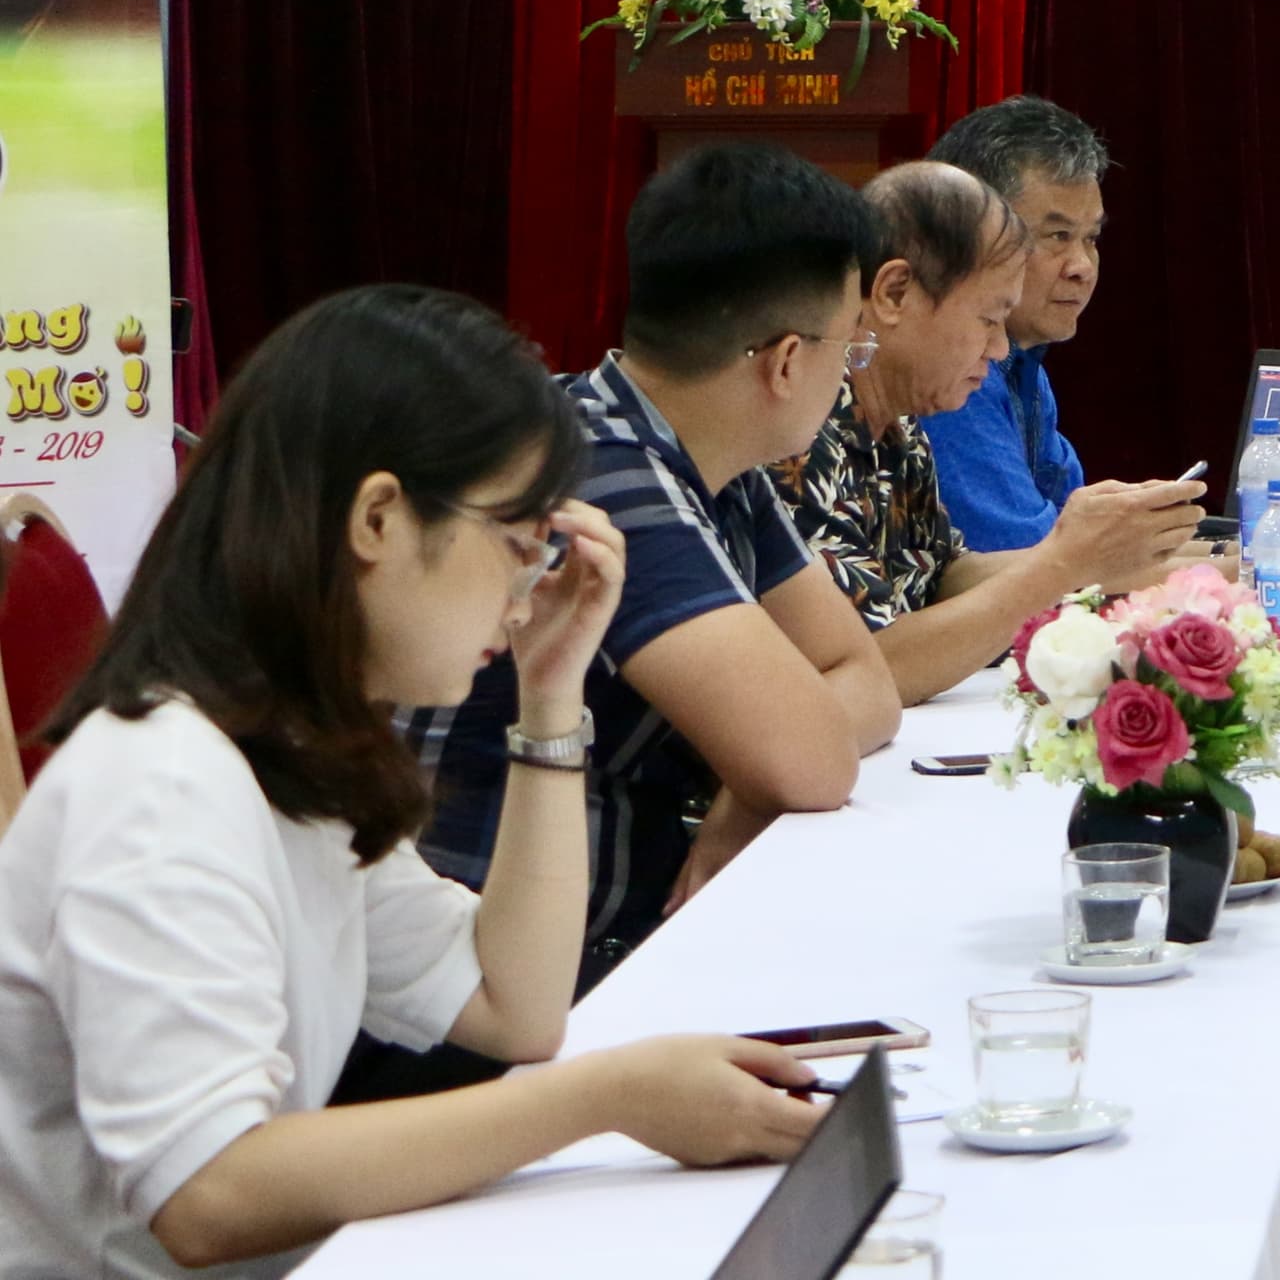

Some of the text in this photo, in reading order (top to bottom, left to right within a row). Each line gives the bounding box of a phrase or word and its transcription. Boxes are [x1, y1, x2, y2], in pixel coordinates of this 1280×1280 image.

[708, 37, 752, 61] CHỦ
[685, 68, 717, 106] HỒ
[726, 70, 766, 106] CHÍ
[0, 302, 90, 355] ng
[37, 430, 104, 462] 2019
